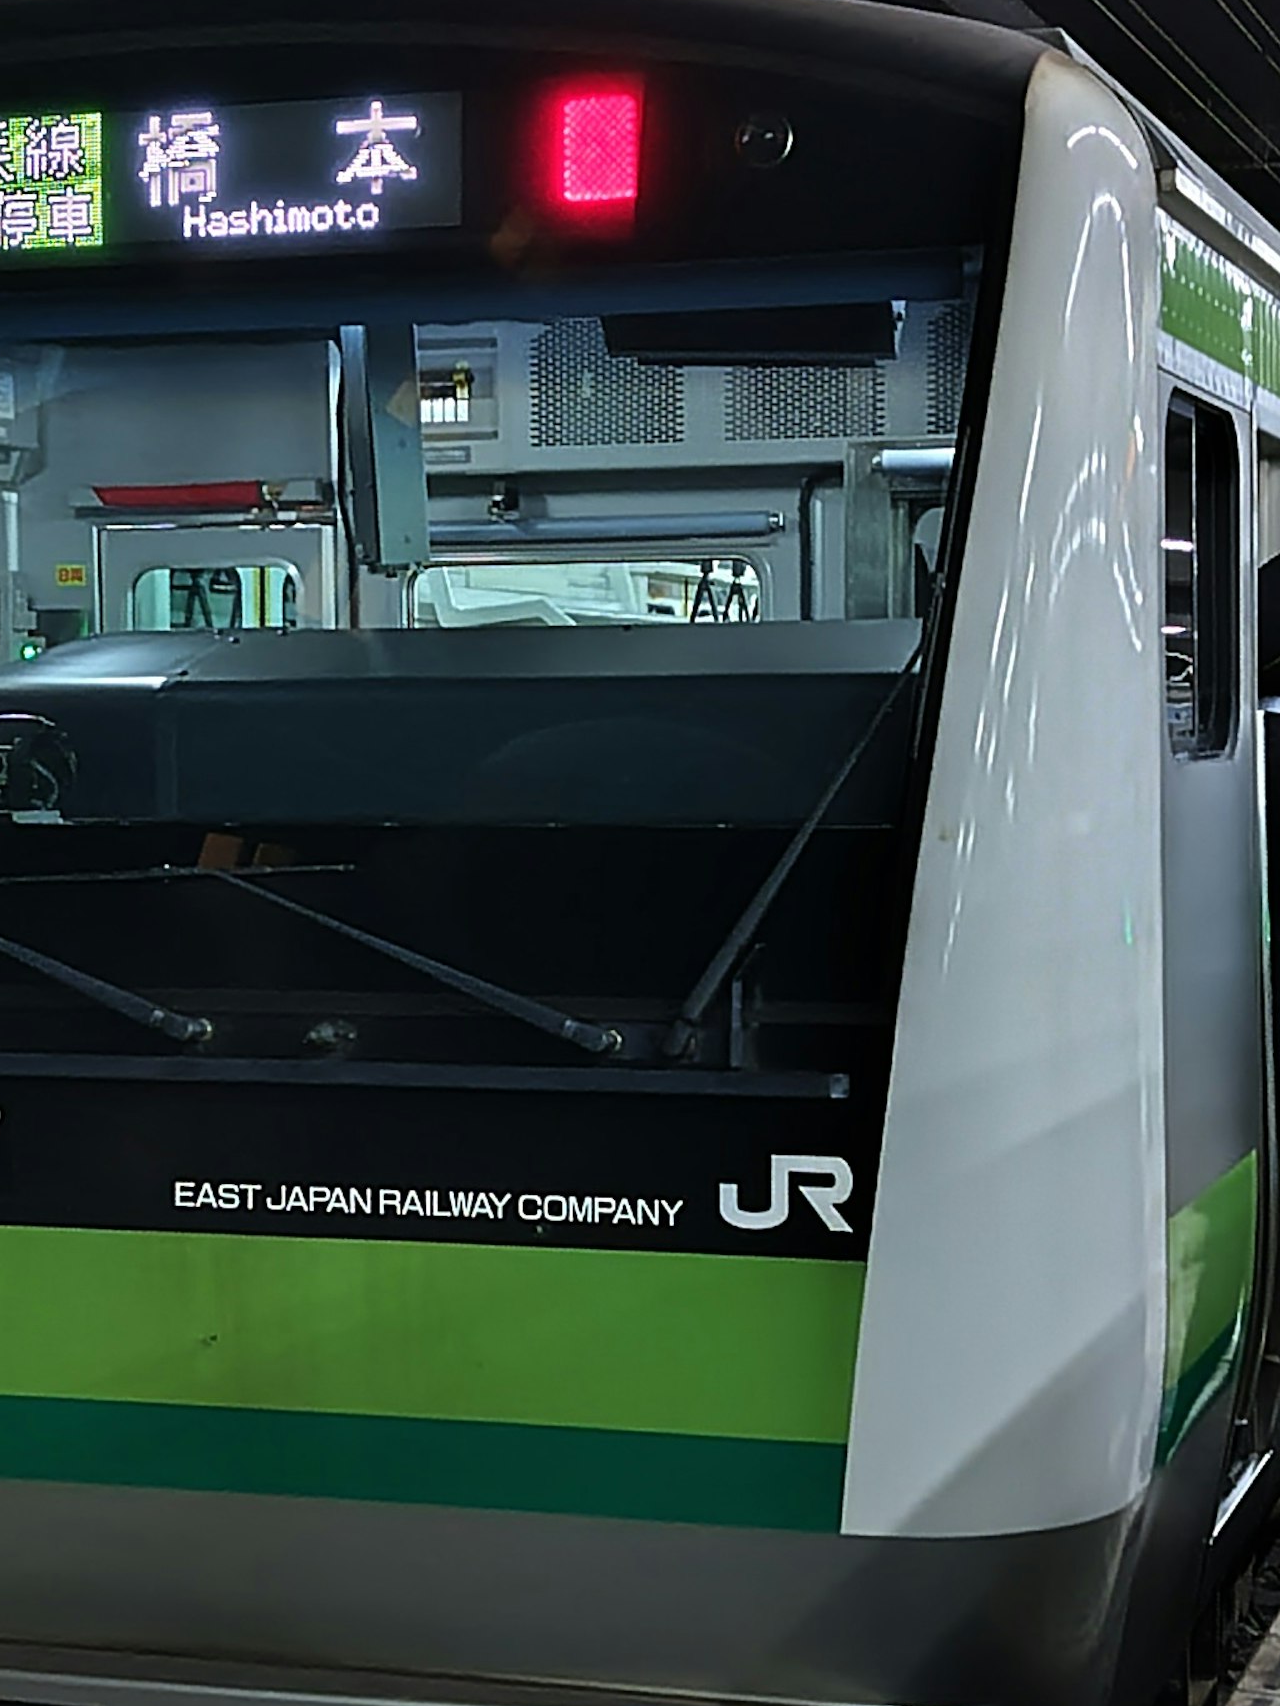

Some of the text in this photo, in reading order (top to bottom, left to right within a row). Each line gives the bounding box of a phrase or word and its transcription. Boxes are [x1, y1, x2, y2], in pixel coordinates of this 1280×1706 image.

[138, 100, 419, 208] 橋本
[182, 200, 380, 238] Hashimoto
[174, 1181, 684, 1227] EAST JAPAN RAILWAY COMPANY
[719, 1154, 854, 1233] JR
